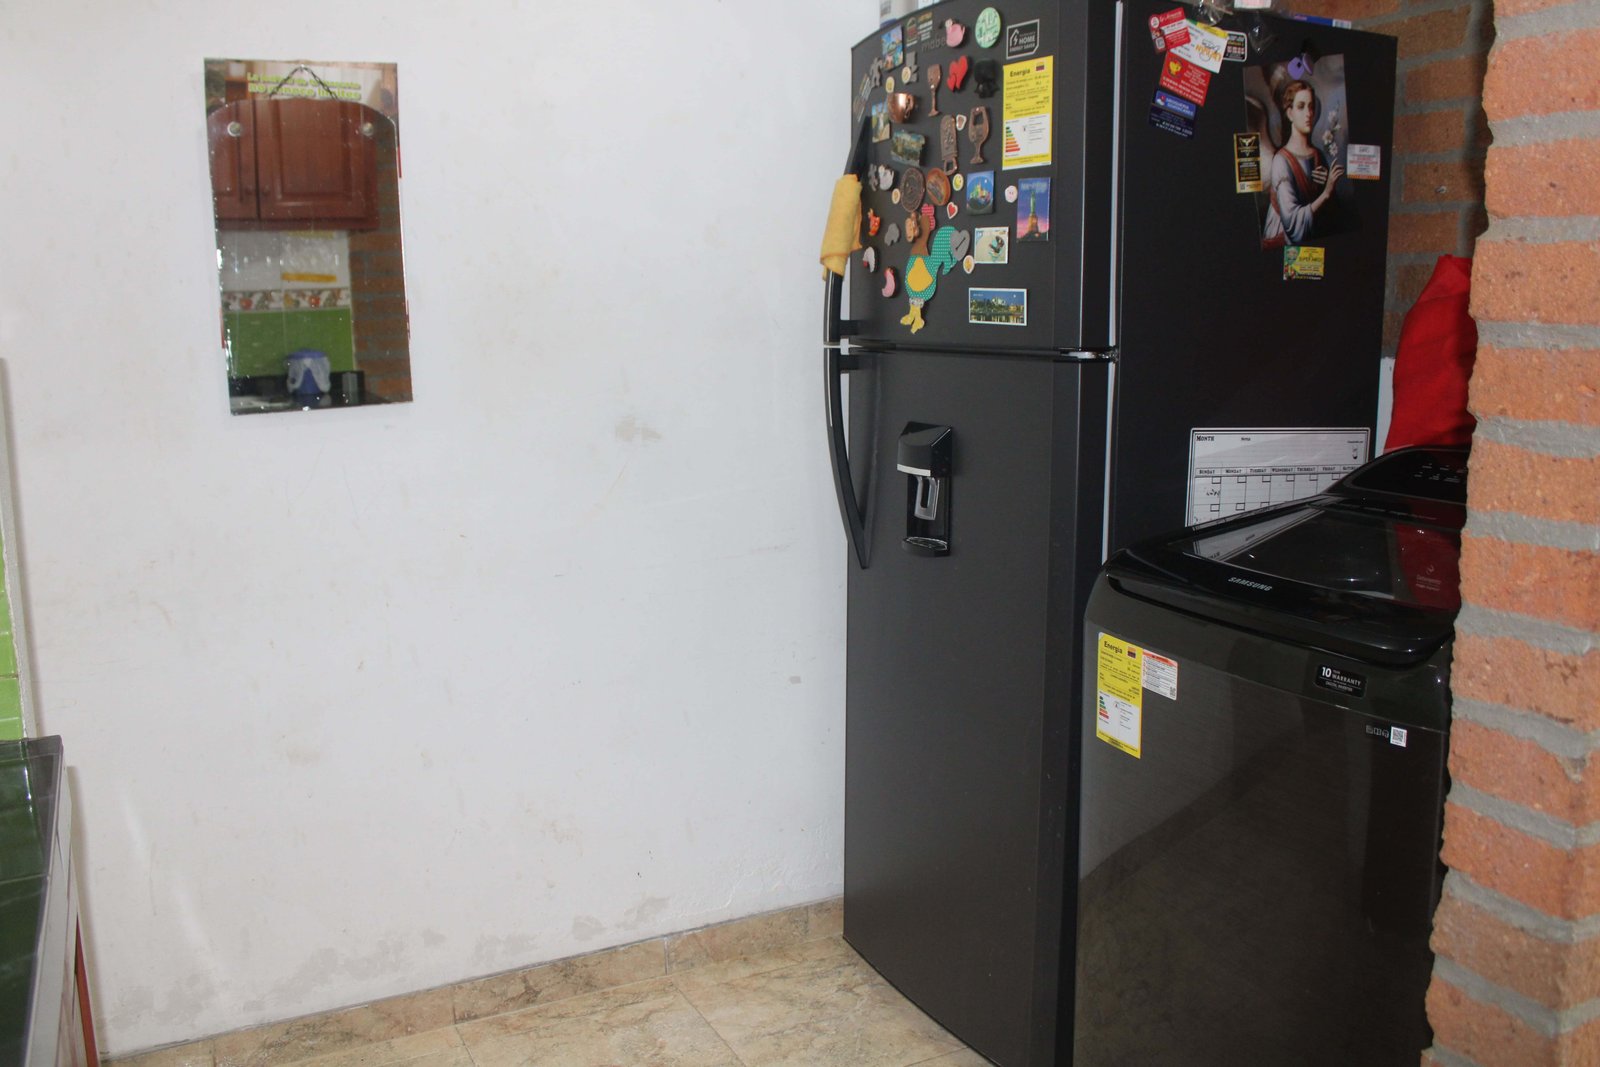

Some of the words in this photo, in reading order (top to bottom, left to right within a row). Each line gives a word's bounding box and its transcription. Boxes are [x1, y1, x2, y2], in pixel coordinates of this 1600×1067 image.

[1019, 35, 1036, 45] HOME
[1228, 577, 1273, 591] SAMSUNG
[1322, 666, 1332, 678] 10
[1332, 673, 1361, 687] WARRANTY
